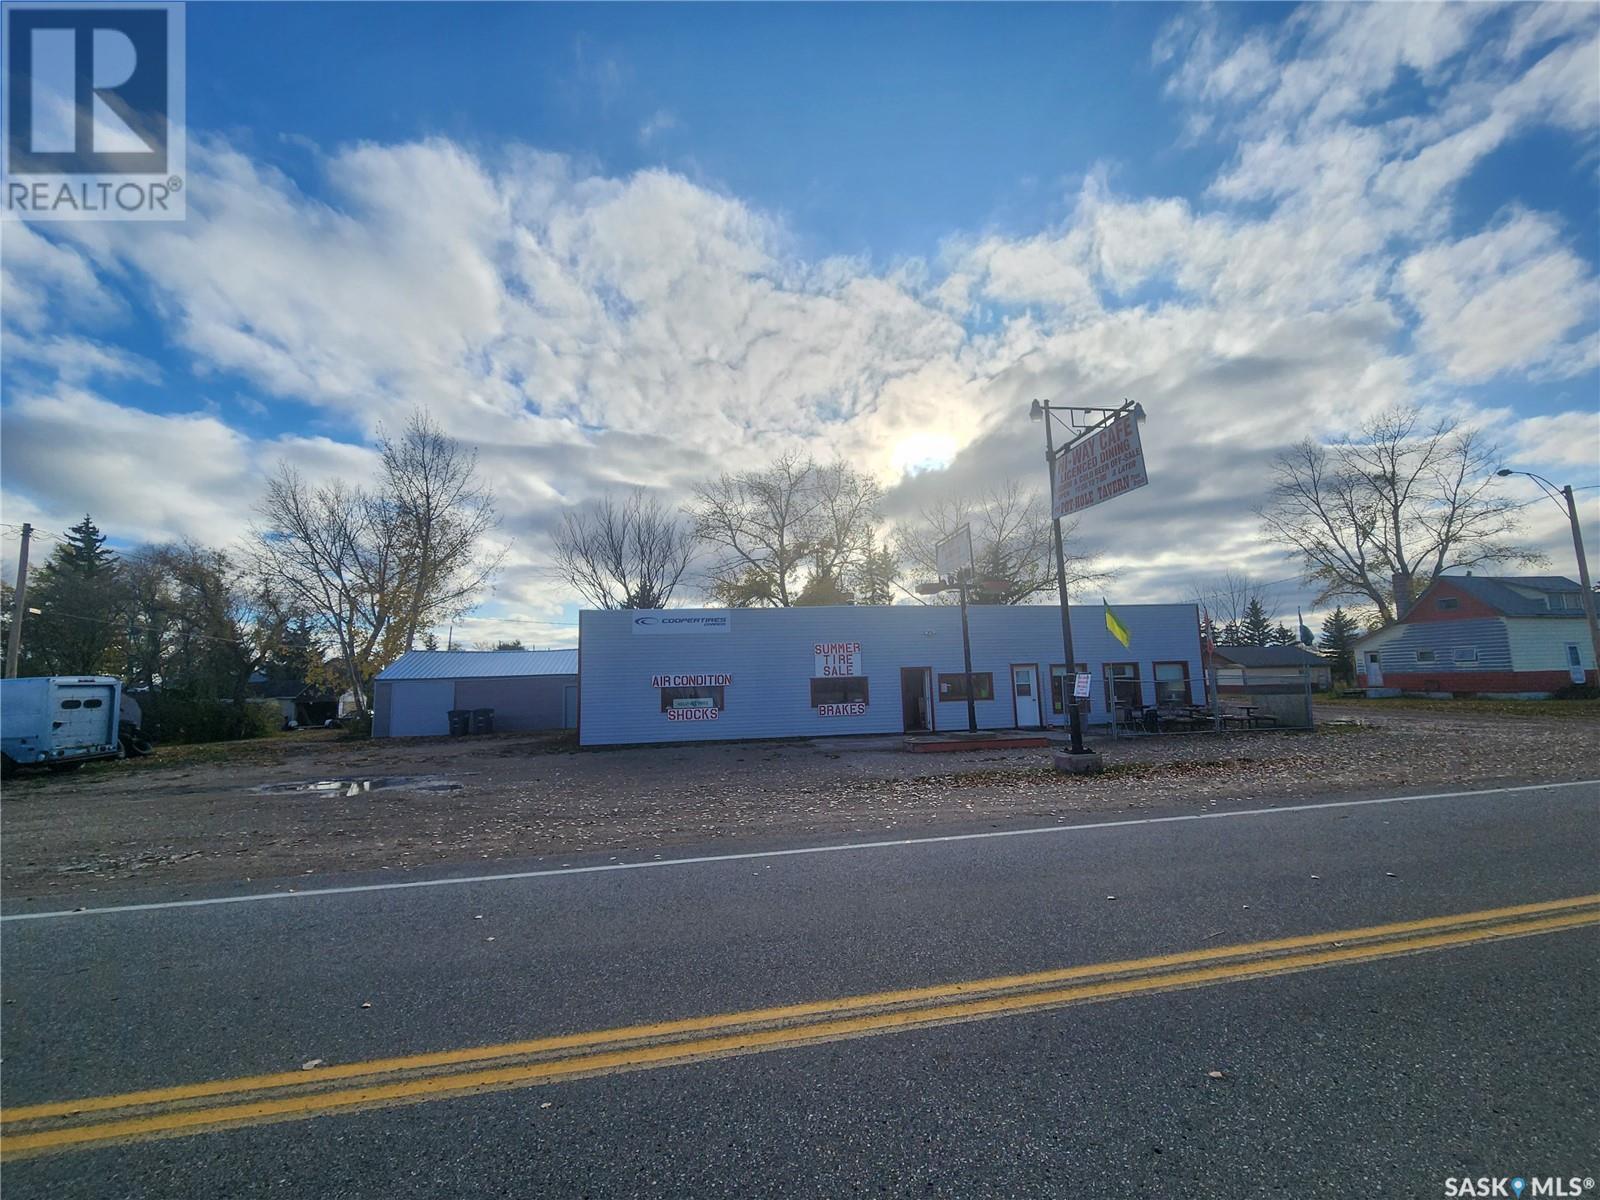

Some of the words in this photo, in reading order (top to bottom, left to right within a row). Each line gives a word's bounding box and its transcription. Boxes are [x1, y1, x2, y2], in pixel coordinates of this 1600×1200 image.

[1099, 417, 1132, 450] CAFE
[1100, 438, 1129, 463] DINING
[1060, 491, 1093, 513] POT-HOLE
[1097, 475, 1130, 499] TAVERN
[815, 643, 861, 655] SUMMER
[823, 655, 853, 665] TIRE
[823, 665, 853, 676] SALE
[652, 675, 671, 687] AIR
[673, 674, 731, 686] CONDITION
[668, 709, 718, 721] SHOCKS
[819, 704, 865, 716] BRAKES
